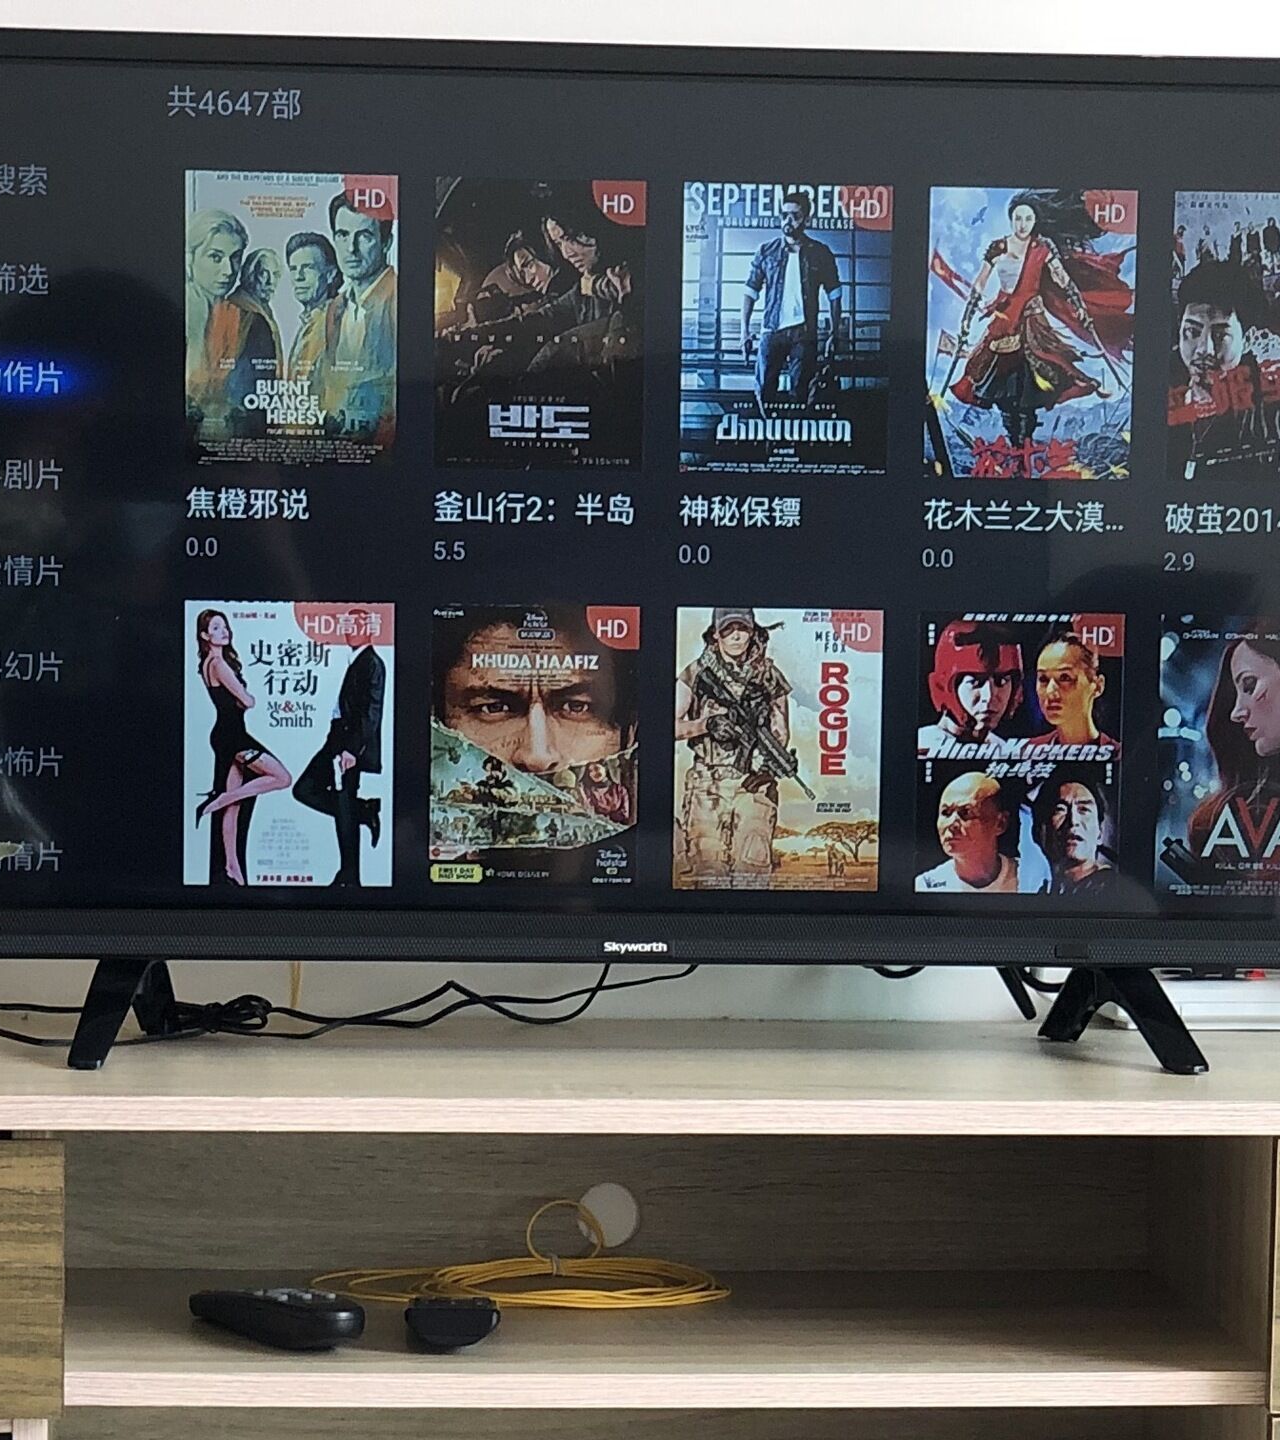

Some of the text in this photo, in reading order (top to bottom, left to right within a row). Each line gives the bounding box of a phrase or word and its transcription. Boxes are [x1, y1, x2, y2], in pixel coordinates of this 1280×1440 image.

[167, 85, 302, 121] 共4647部
[354, 189, 385, 209] HD
[602, 194, 635, 214] HD
[849, 199, 880, 219] HD
[1094, 203, 1125, 223] HD
[812, 219, 854, 230] RELEASE
[256, 379, 311, 396] BURNT
[244, 394, 319, 411] ORANGE
[266, 409, 328, 426] HERESY
[489, 404, 590, 439] 반도
[186, 488, 310, 520] 焦橙邪说
[679, 497, 802, 528] 神秘保镖
[186, 537, 218, 557] 0.0
[434, 542, 466, 561] 5.5
[678, 545, 711, 564] 0.0
[922, 549, 954, 568] 0.0
[1164, 552, 1195, 572] 2.9
[304, 612, 382, 637] HD高清
[596, 619, 628, 639] HD
[840, 623, 872, 642] HD
[1081, 626, 1114, 646] HD
[248, 639, 331, 667] 史密斯
[824, 642, 846, 653] FOX
[472, 653, 600, 670] KHUDA HAAFIZ
[264, 669, 318, 696] 行动
[269, 710, 313, 728] Smith
[819, 662, 850, 775] ROGUE
[927, 738, 1114, 760] HIGH KICKERS
[603, 942, 668, 955] Skyworth
